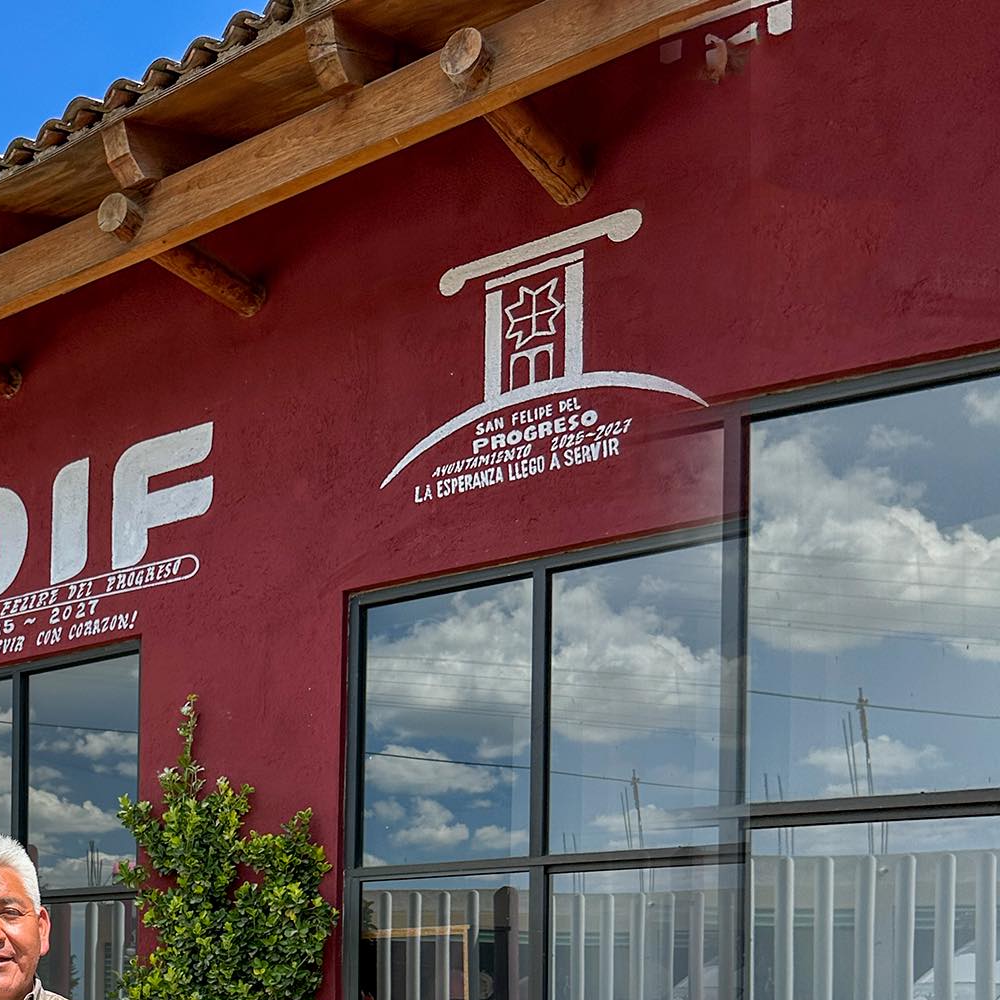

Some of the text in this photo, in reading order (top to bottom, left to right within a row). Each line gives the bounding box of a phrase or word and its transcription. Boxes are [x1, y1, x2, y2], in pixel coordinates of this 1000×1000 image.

[472, 409, 598, 454] PROGRESO
[475, 397, 581, 435] SAN FELIPE DEL
[414, 437, 620, 503] LA ESPERANZA LLEGO A SERVIR
[432, 444, 532, 478] AYUNTAMIENTO
[0, 588, 60, 617] FELIPE
[68, 581, 92, 600] DEL
[106, 559, 182, 592] PROGRESO
[36, 626, 62, 646] CON
[68, 610, 138, 640] CORAZON!
[49, 599, 99, 625] 2027
